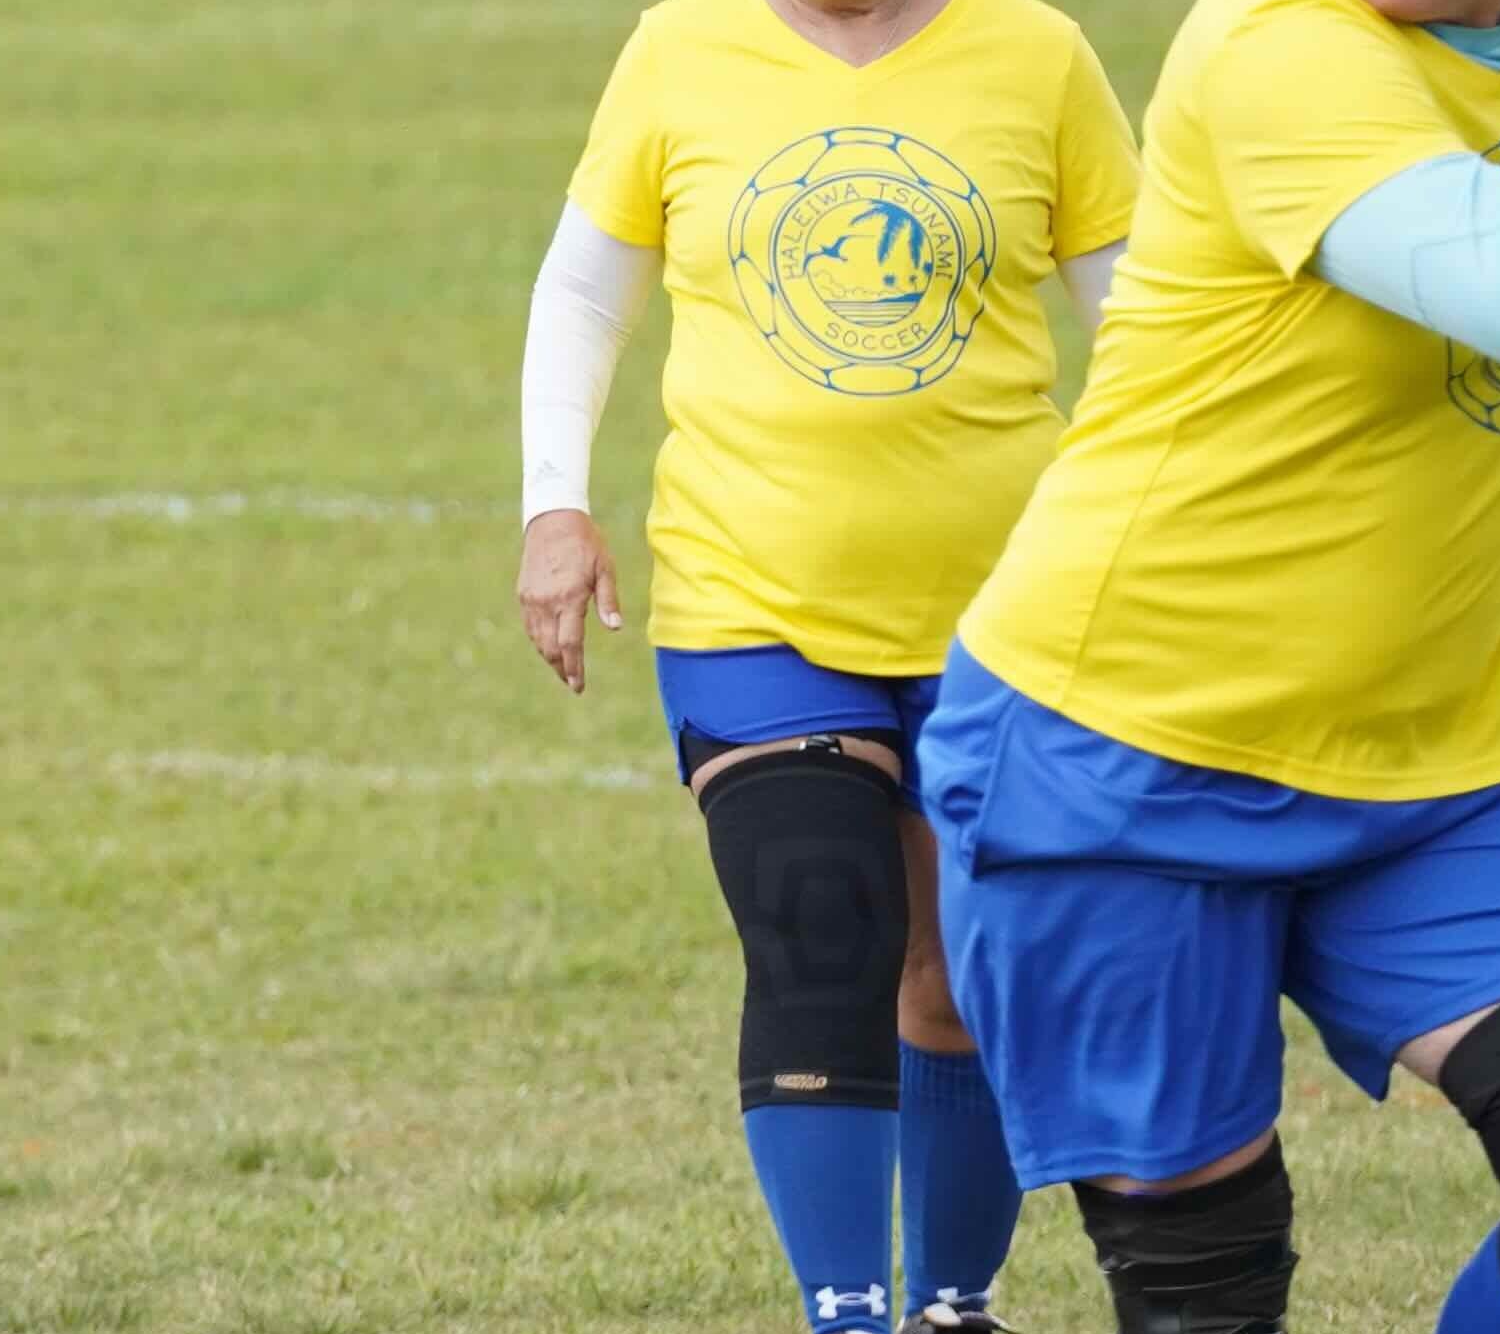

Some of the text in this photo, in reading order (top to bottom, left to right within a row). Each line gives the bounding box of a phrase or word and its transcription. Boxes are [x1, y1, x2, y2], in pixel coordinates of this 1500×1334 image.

[781, 181, 953, 281] HALEIWA TSUNAMI
[824, 322, 928, 351] SOCCER
